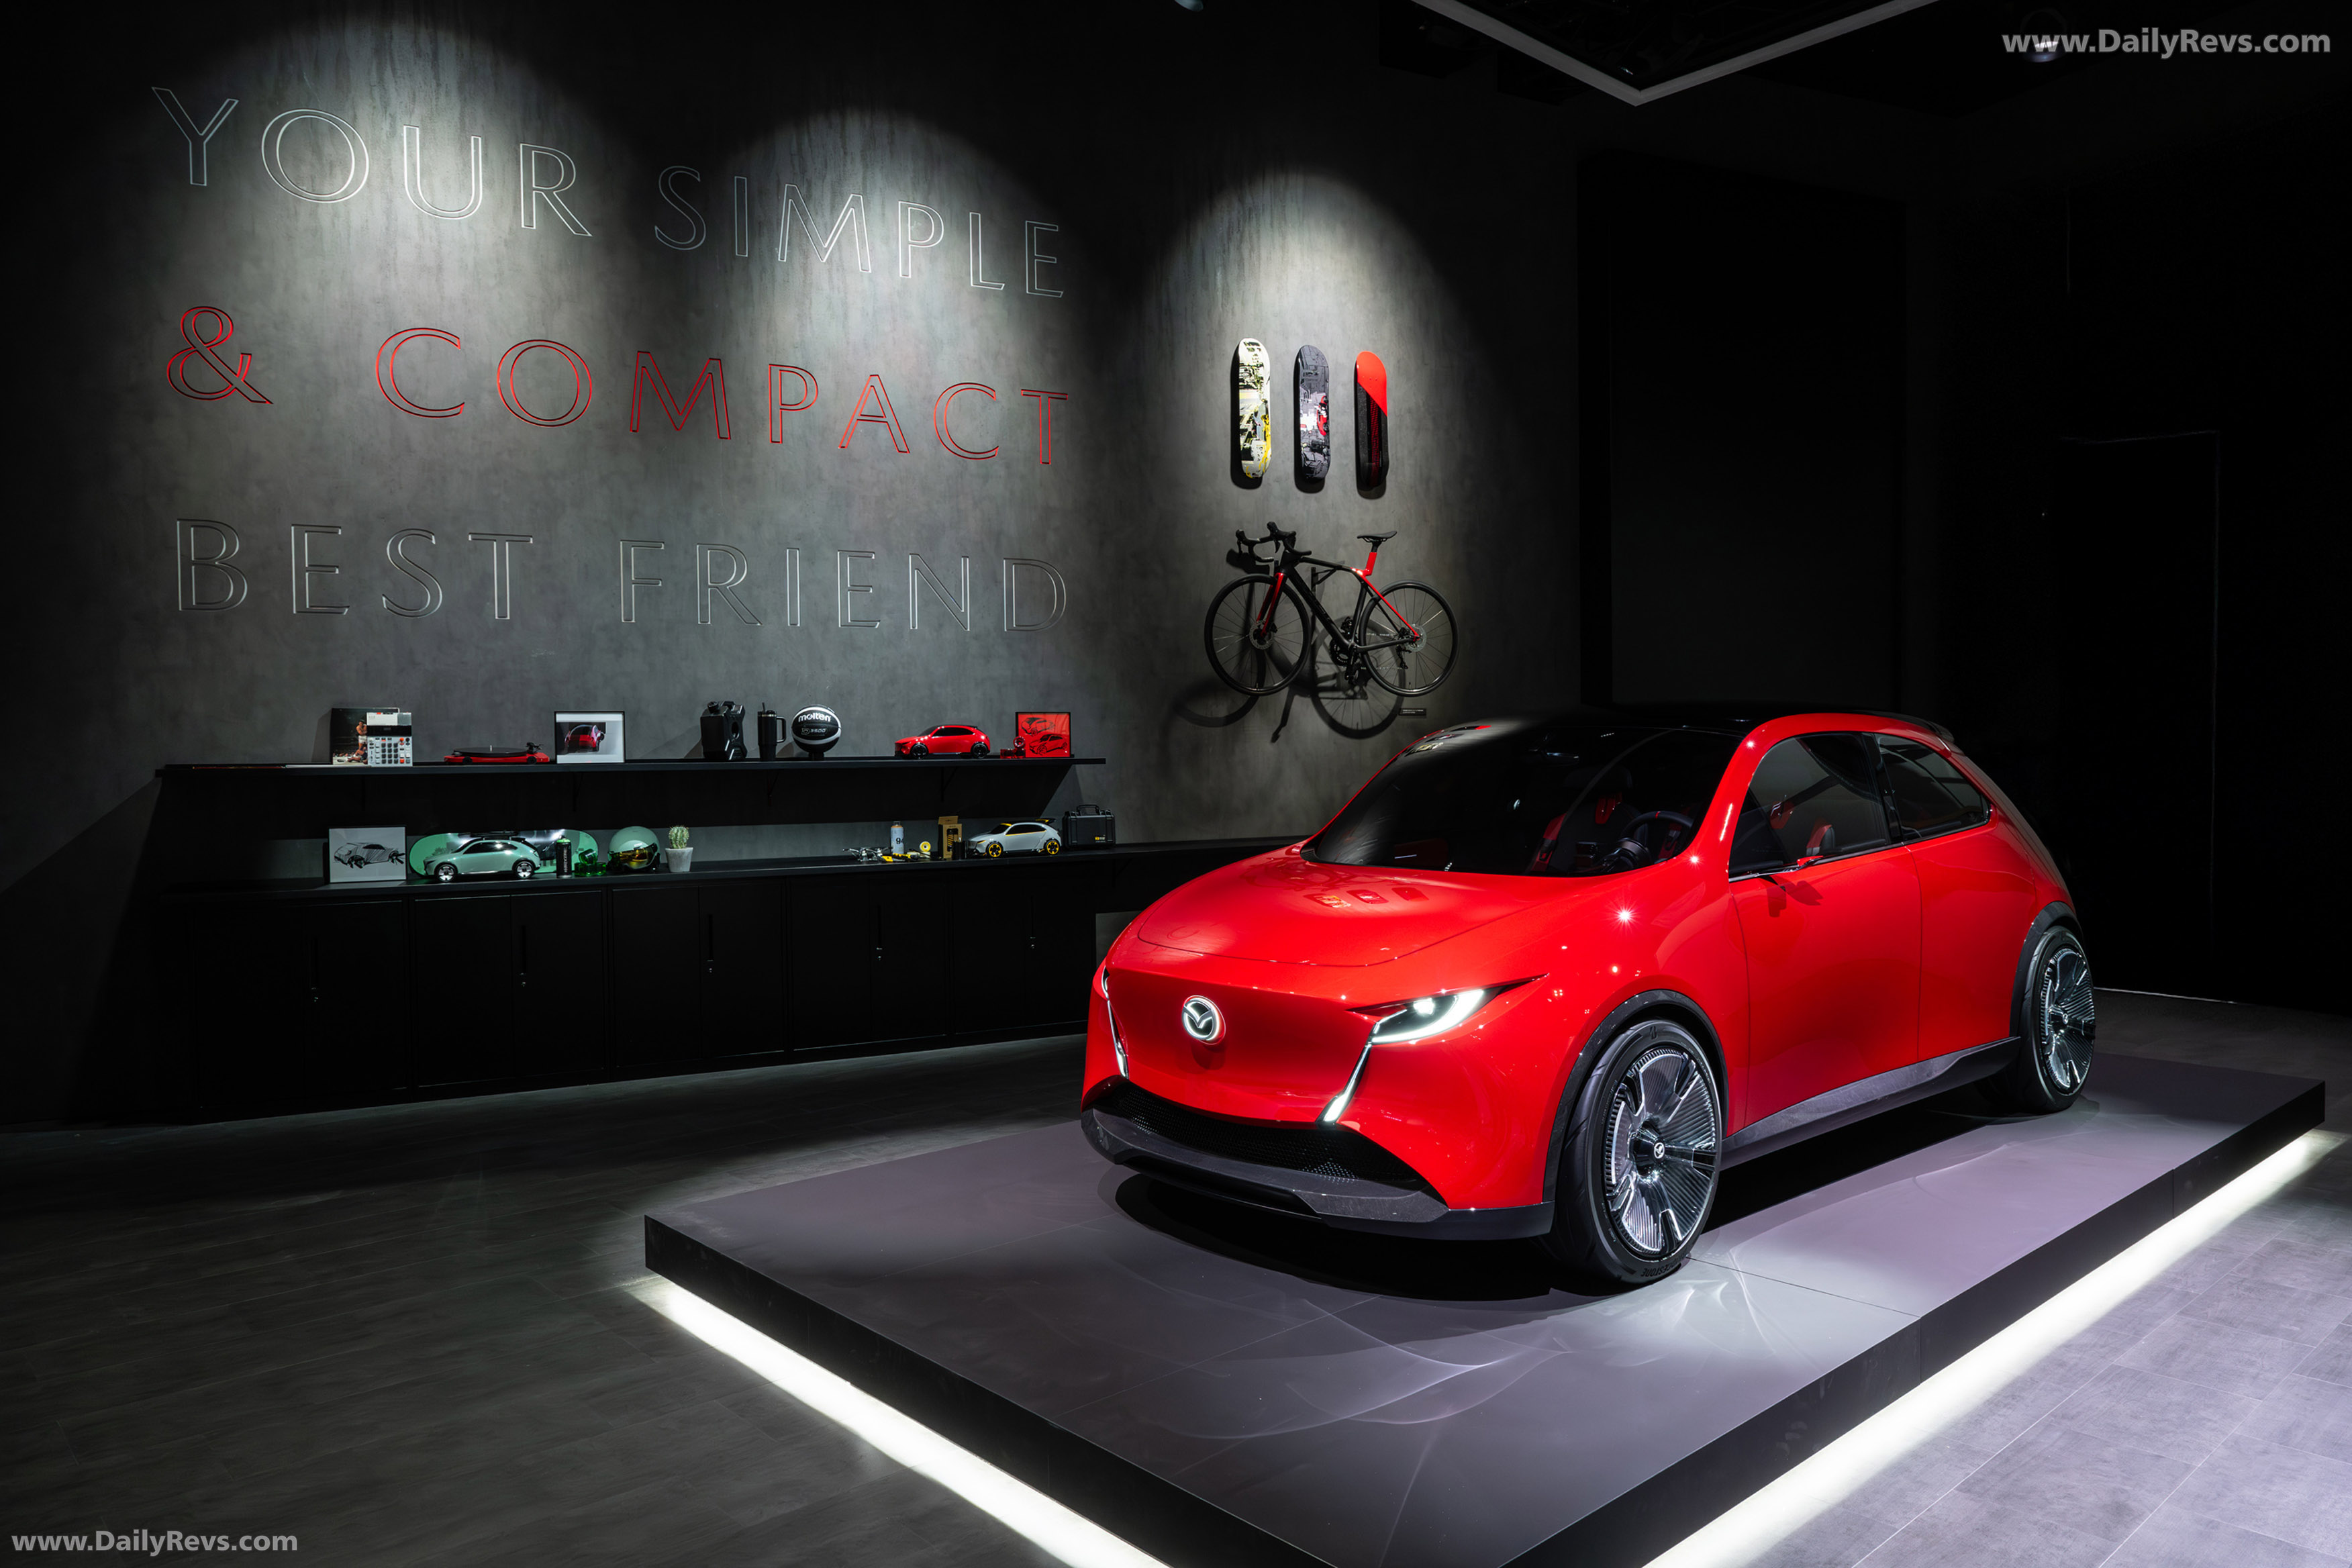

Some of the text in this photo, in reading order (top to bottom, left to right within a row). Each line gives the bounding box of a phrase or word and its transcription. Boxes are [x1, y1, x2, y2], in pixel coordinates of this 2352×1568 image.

[151, 86, 1063, 297] YOUR SIMPLE
[166, 305, 1069, 464] & COMPACT
[176, 518, 1067, 632] BEST FRIEND
[798, 712, 831, 722] molten
